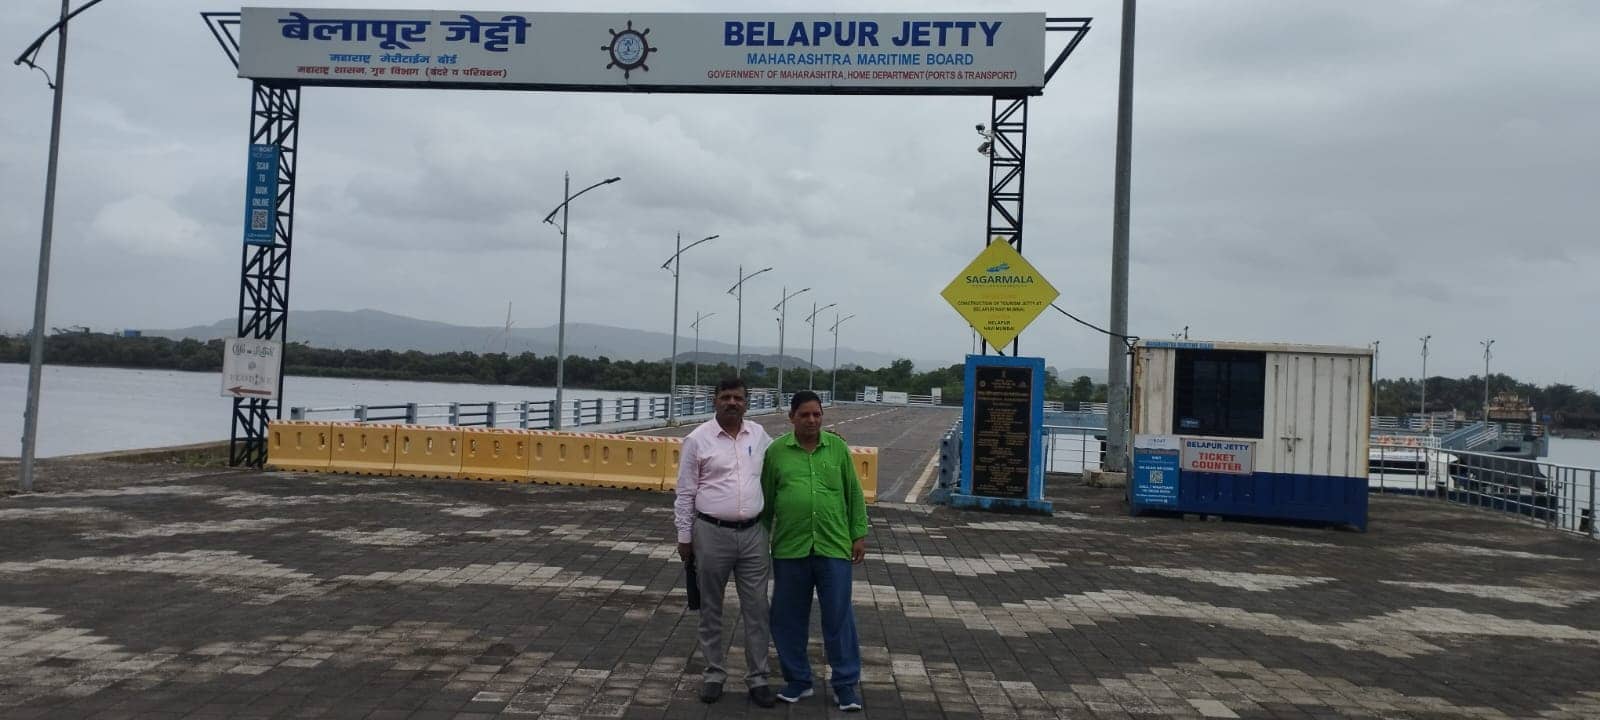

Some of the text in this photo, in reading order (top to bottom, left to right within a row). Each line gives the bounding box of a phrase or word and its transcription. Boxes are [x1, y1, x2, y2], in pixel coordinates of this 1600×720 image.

[278, 12, 532, 52] बेलापूर जेट्टी
[723, 21, 1003, 47] BELAPUR JETTY
[329, 53, 459, 64] महाराष्ट्र मेरीटाईम बोर्ड
[747, 53, 974, 65] MAHARASHTRA MARITIME BOARD
[297, 65, 330, 75] महाराष्ट्र
[390, 66, 419, 76] विभाग
[707, 70, 765, 79] GOVERNMENT
[767, 70, 778, 79] OF
[848, 71, 871, 80] HOME
[964, 71, 1017, 81] TRANSPORT)
[966, 275, 1034, 284] SAGARMALA
[1186, 441, 1249, 451] BELAPUR JETTY
[1199, 452, 1235, 462] TICKET
[1191, 461, 1242, 471] COUNTER
